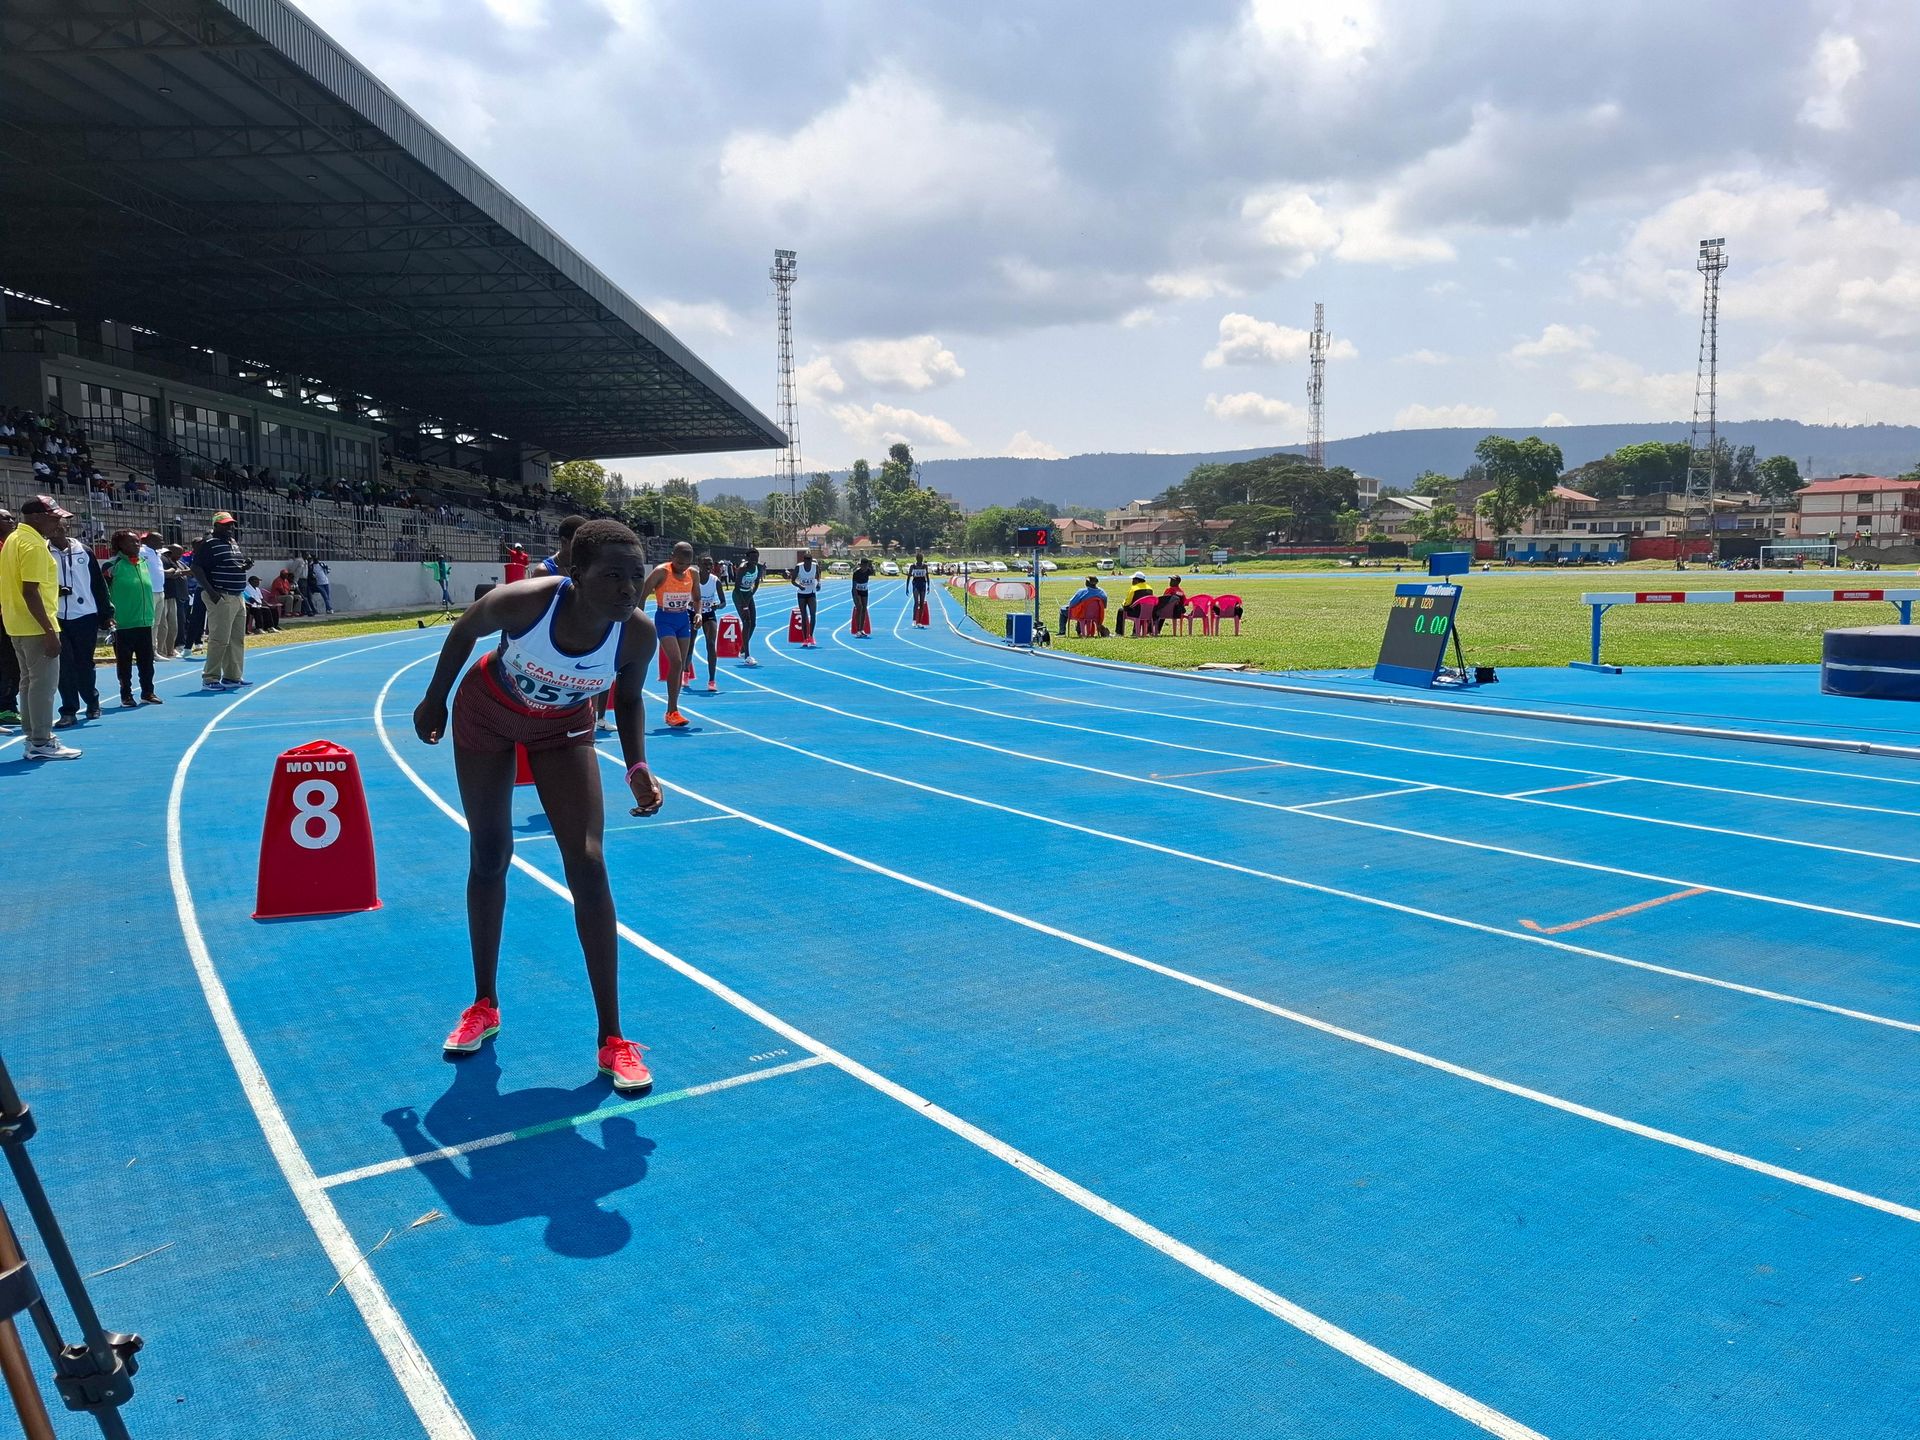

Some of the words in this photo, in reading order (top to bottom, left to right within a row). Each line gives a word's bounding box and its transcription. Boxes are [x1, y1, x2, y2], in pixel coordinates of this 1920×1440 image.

[1036, 530, 1046, 545] 2
[794, 614, 803, 630] 3
[723, 623, 738, 643] 4
[524, 669, 570, 687] COMBINED
[526, 661, 554, 678] CAA
[559, 674, 604, 686] U18/20
[290, 779, 341, 849] 8
